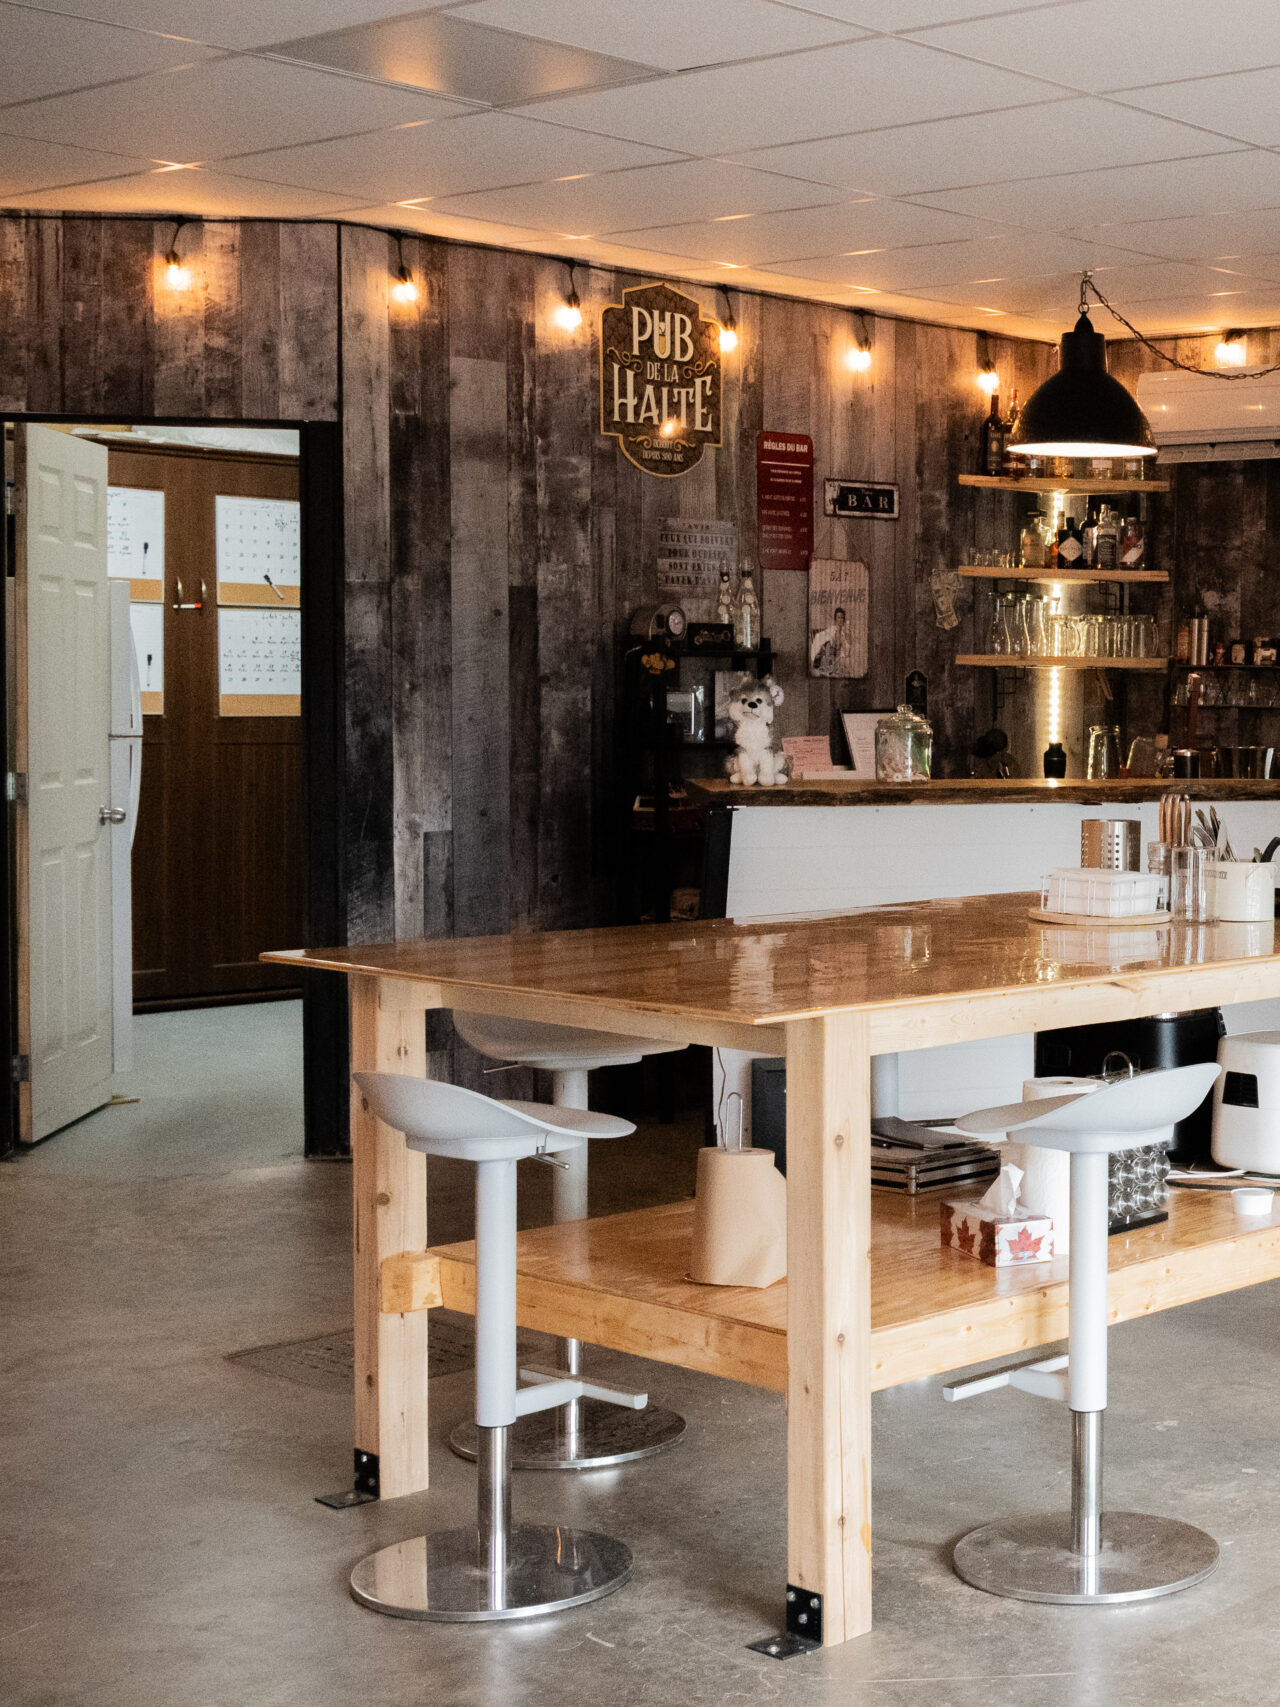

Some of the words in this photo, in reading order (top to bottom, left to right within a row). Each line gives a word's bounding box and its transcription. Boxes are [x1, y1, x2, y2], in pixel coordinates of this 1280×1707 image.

[632, 306, 694, 362] PUB
[647, 361, 661, 381] DE
[664, 363, 679, 383] LA
[612, 362, 713, 432] HALTE
[763, 440, 786, 451] RÈGLES
[786, 443, 795, 452] DU
[796, 444, 808, 453] BAR
[847, 494, 889, 509] BAR
